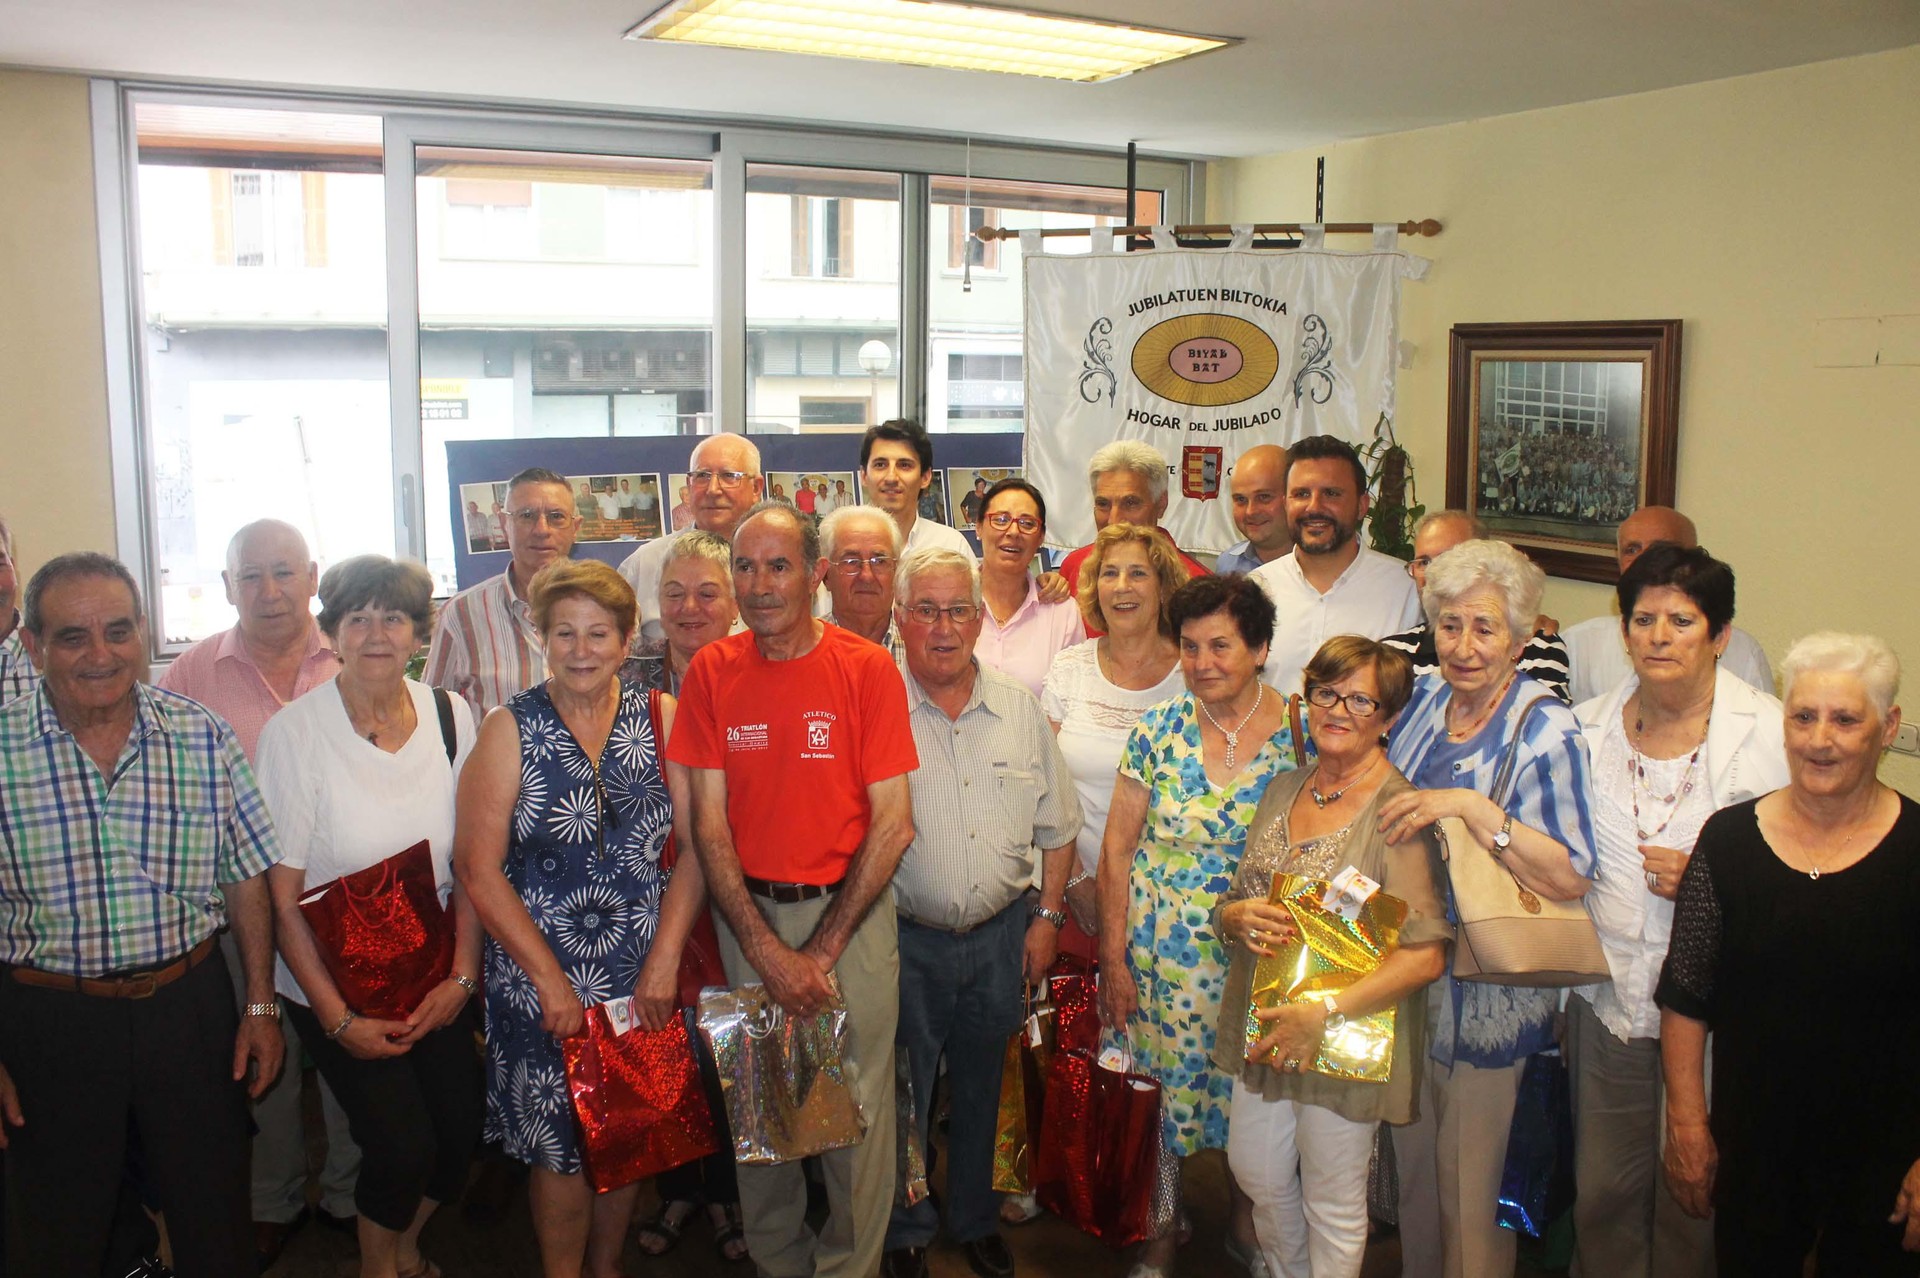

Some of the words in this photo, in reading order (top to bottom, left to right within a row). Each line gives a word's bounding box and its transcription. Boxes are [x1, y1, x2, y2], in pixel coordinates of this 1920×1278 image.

[1128, 288, 1218, 317] JUBILATUEN
[1221, 289, 1288, 316] BILTOKIA
[1192, 362, 1220, 374] BAT
[1127, 408, 1181, 430] HOGAR
[1189, 421, 1208, 432] DEL
[1212, 407, 1282, 432] JUBILADO
[803, 711, 837, 721] ATLETICO
[727, 726, 740, 741] 26
